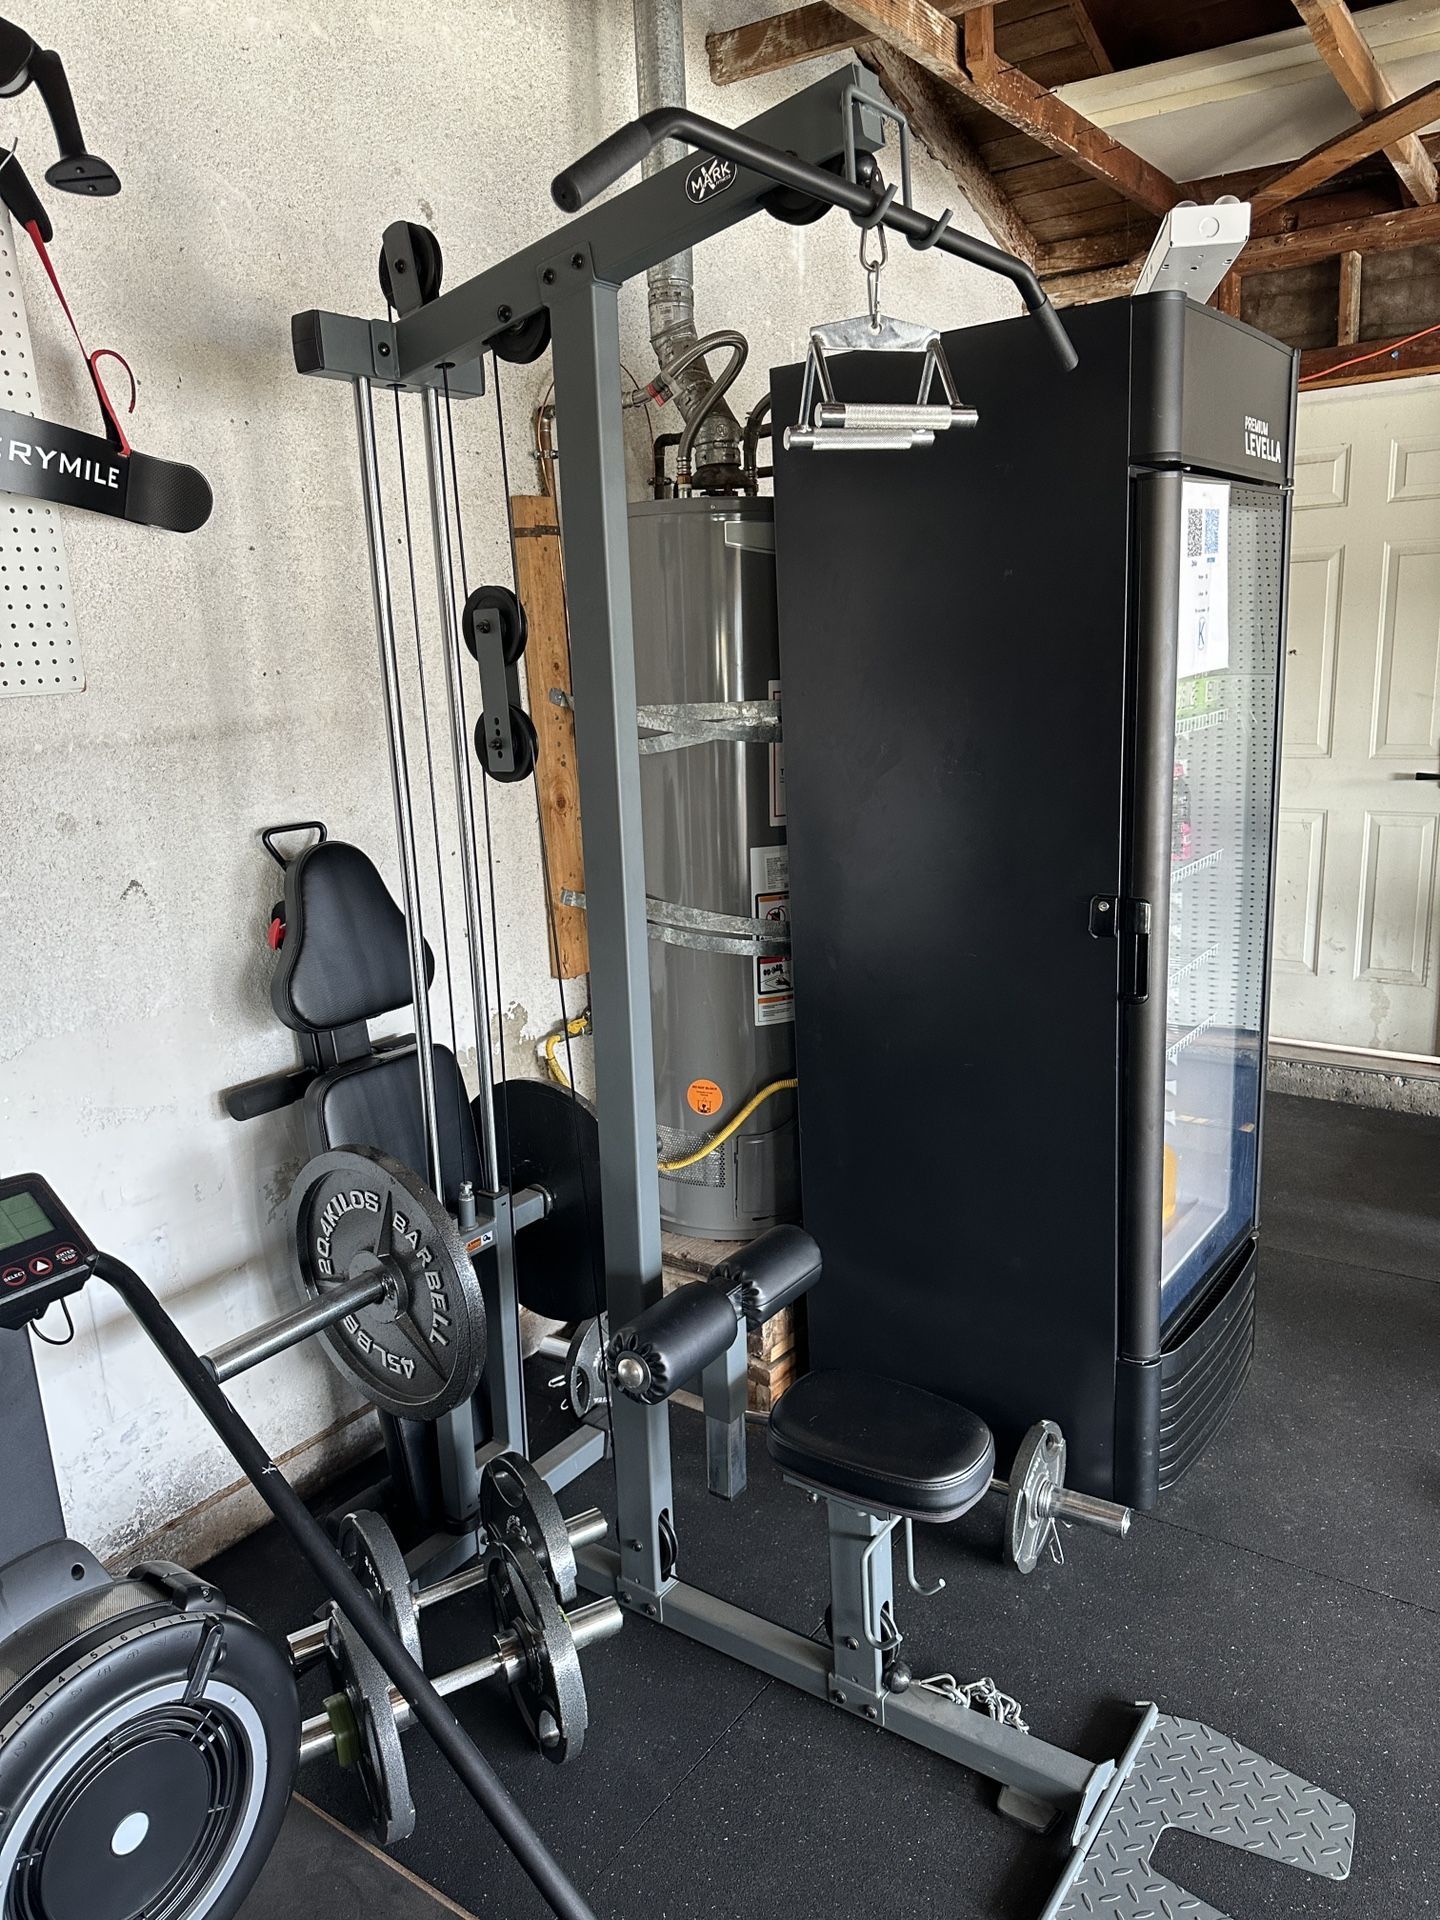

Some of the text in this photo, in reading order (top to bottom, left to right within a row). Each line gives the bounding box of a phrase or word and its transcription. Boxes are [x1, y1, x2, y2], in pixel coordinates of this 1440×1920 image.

[1245, 415, 1269, 437] PREMIUM
[1245, 431, 1282, 464] LEVELLA
[0, 437, 119, 489] RYMILE
[56, 1249, 77, 1260] ENTER
[61, 1254, 76, 1262] STOP
[3, 1271, 25, 1283] SELECT
[393, 1212, 450, 1347] BARBELL
[26, 1703, 35, 1712] 3
[57, 1676, 66, 1684] 4
[90, 1652, 98, 1660] 5
